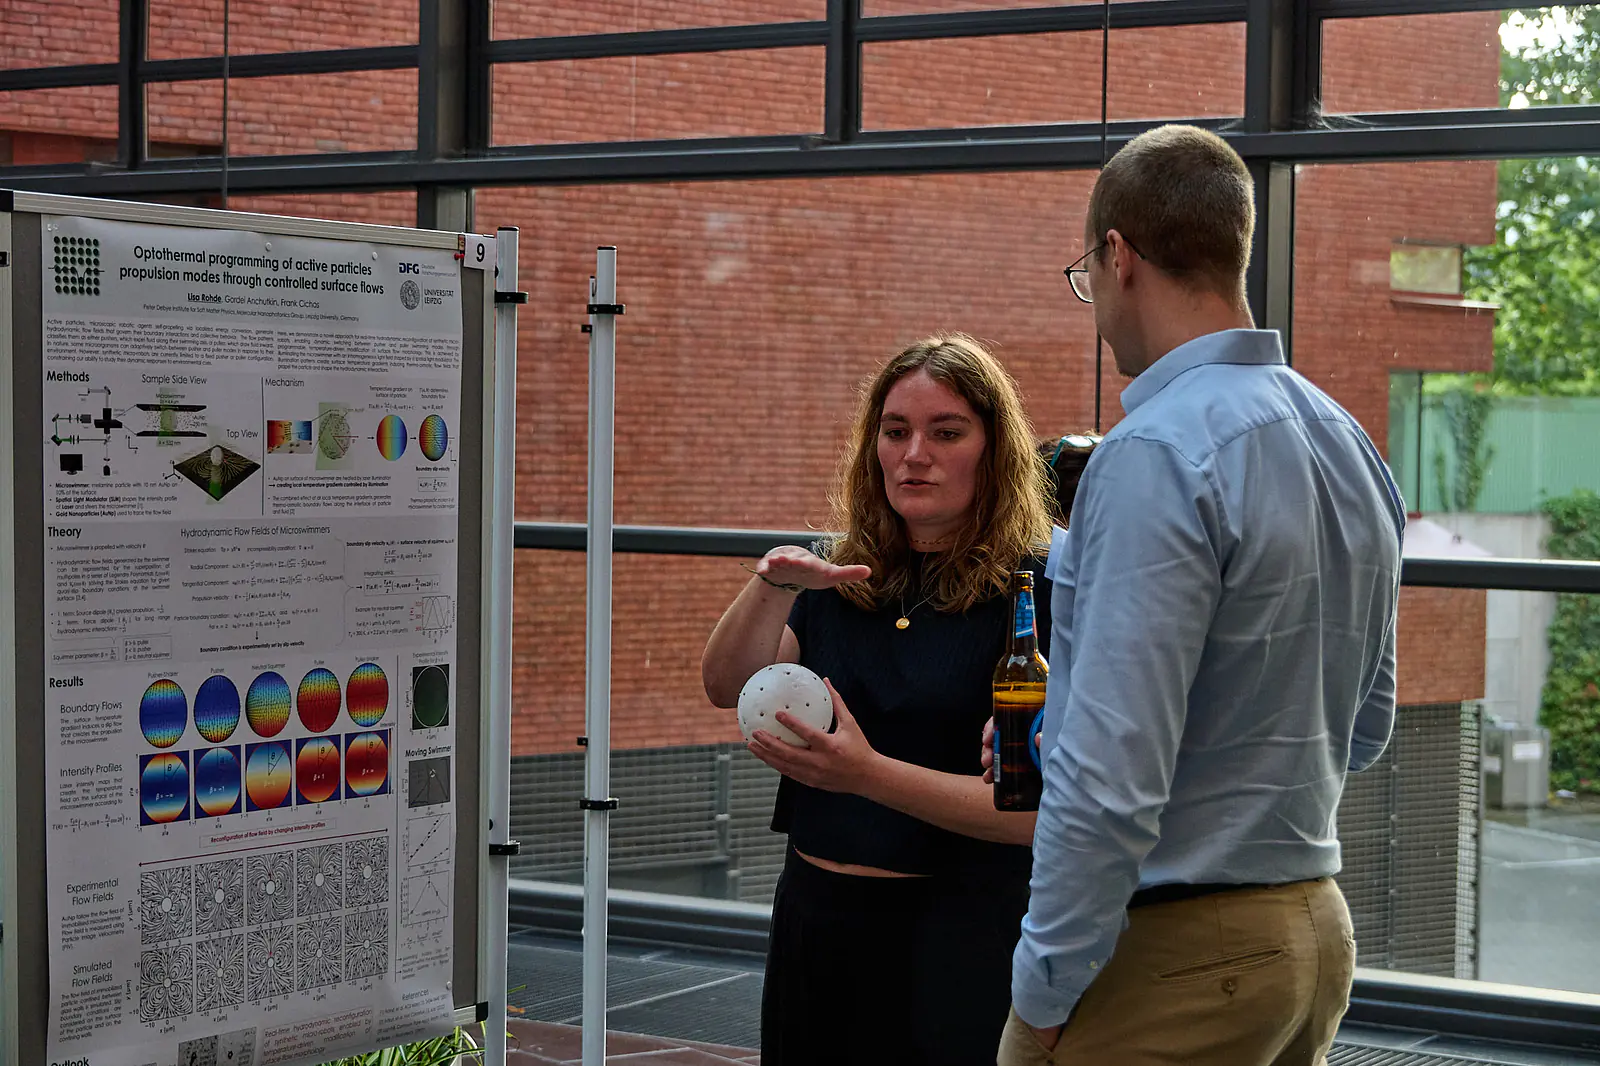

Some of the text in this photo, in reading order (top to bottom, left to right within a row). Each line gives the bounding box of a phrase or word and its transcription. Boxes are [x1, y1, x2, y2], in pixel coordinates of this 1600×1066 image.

[134, 246, 372, 278] Optothermal programming of active particles
[399, 262, 419, 274] DFG
[120, 266, 384, 294] propulsion modes through controlled surface flows
[188, 293, 200, 301] Lisa
[281, 299, 297, 308] Frank
[299, 300, 319, 308] Cichos
[47, 371, 89, 382] Methods
[142, 374, 207, 384] Sample Side View
[265, 378, 304, 387] Mechanism
[227, 429, 258, 439] Top View
[48, 526, 81, 538] Theory
[181, 528, 232, 538] Hydrodynamic
[252, 526, 270, 535] Fields
[280, 525, 330, 534] Microswimmers
[50, 676, 84, 688] Results
[60, 701, 122, 714] Boundary Flows
[60, 764, 122, 777] Intensity Profiles
[66, 878, 118, 894] Experimental
[72, 892, 114, 905] Flow Fields
[73, 960, 112, 975] Simulated
[72, 973, 113, 987] Flow Fields
